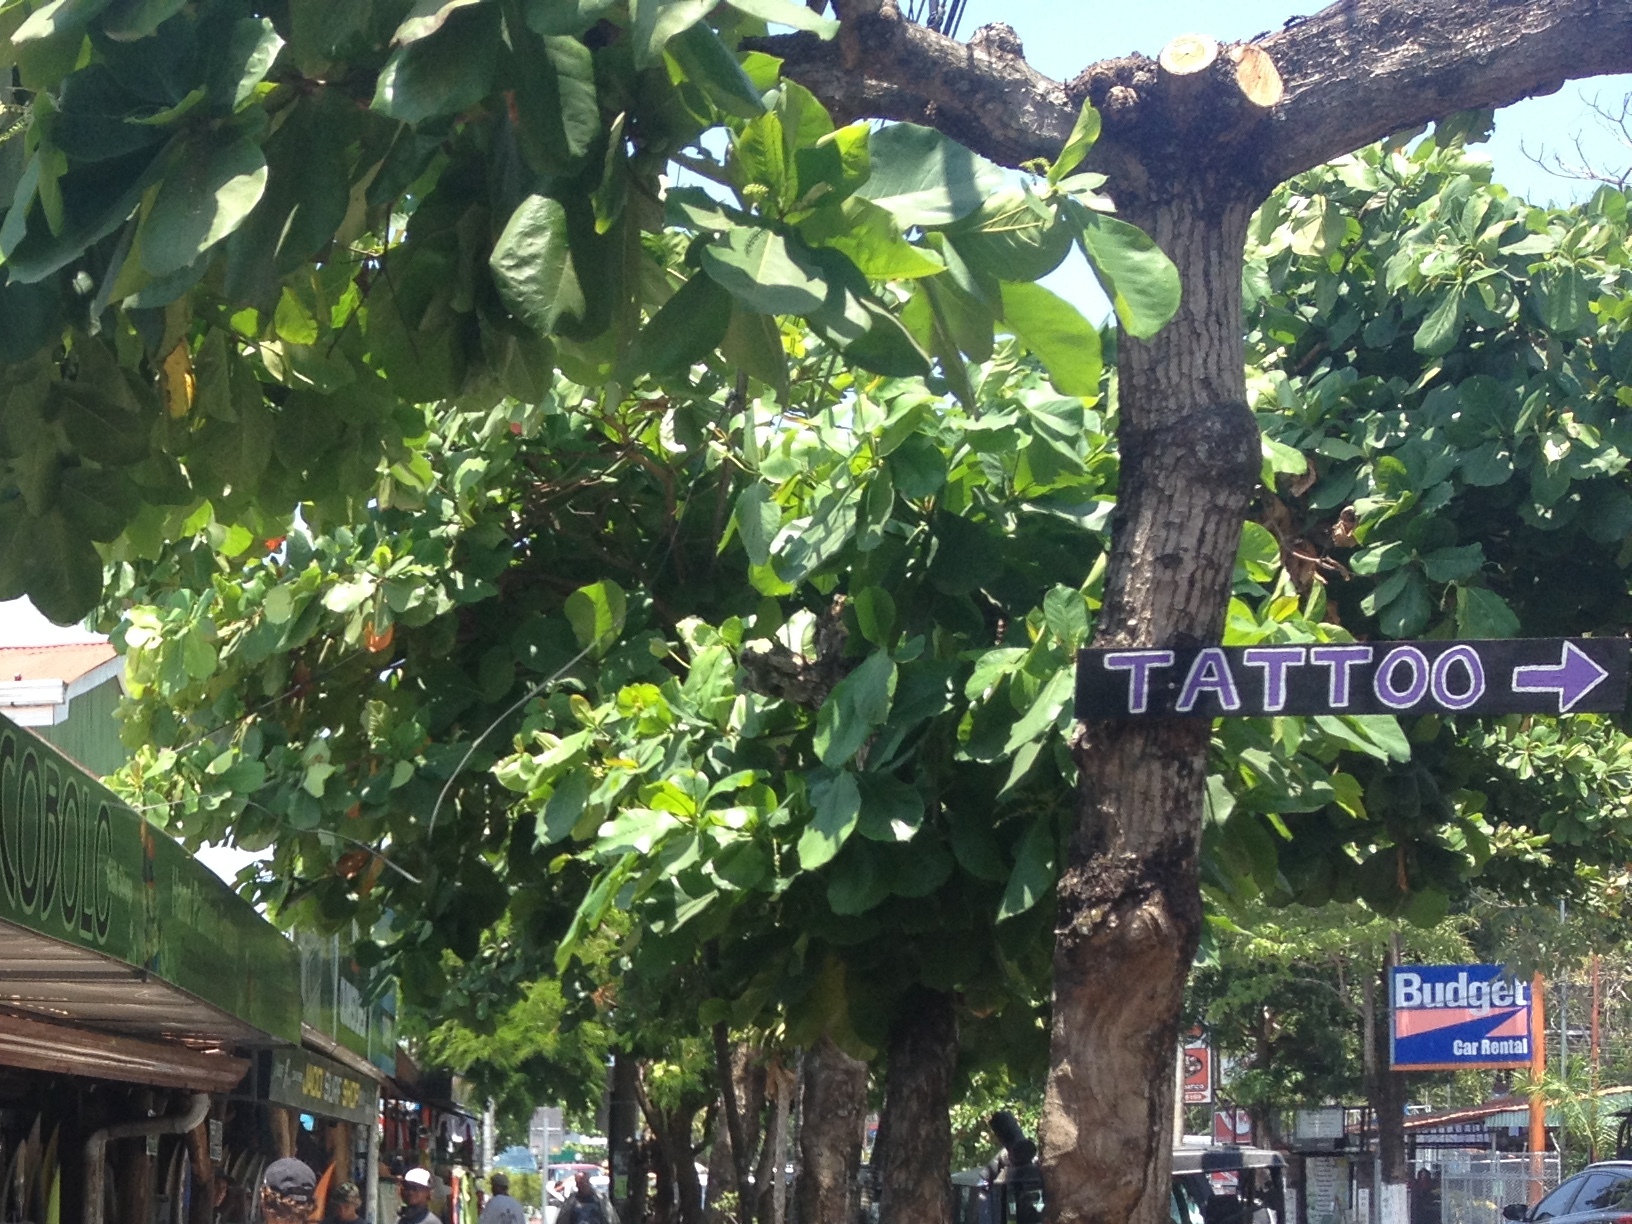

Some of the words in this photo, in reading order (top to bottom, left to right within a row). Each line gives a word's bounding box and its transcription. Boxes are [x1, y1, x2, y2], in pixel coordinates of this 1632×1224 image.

[1103, 644, 1486, 714] TATTOO
[1394, 971, 1528, 1017] Budget
[1453, 1039, 1479, 1056] Car
[1480, 1038, 1528, 1055] Rental
